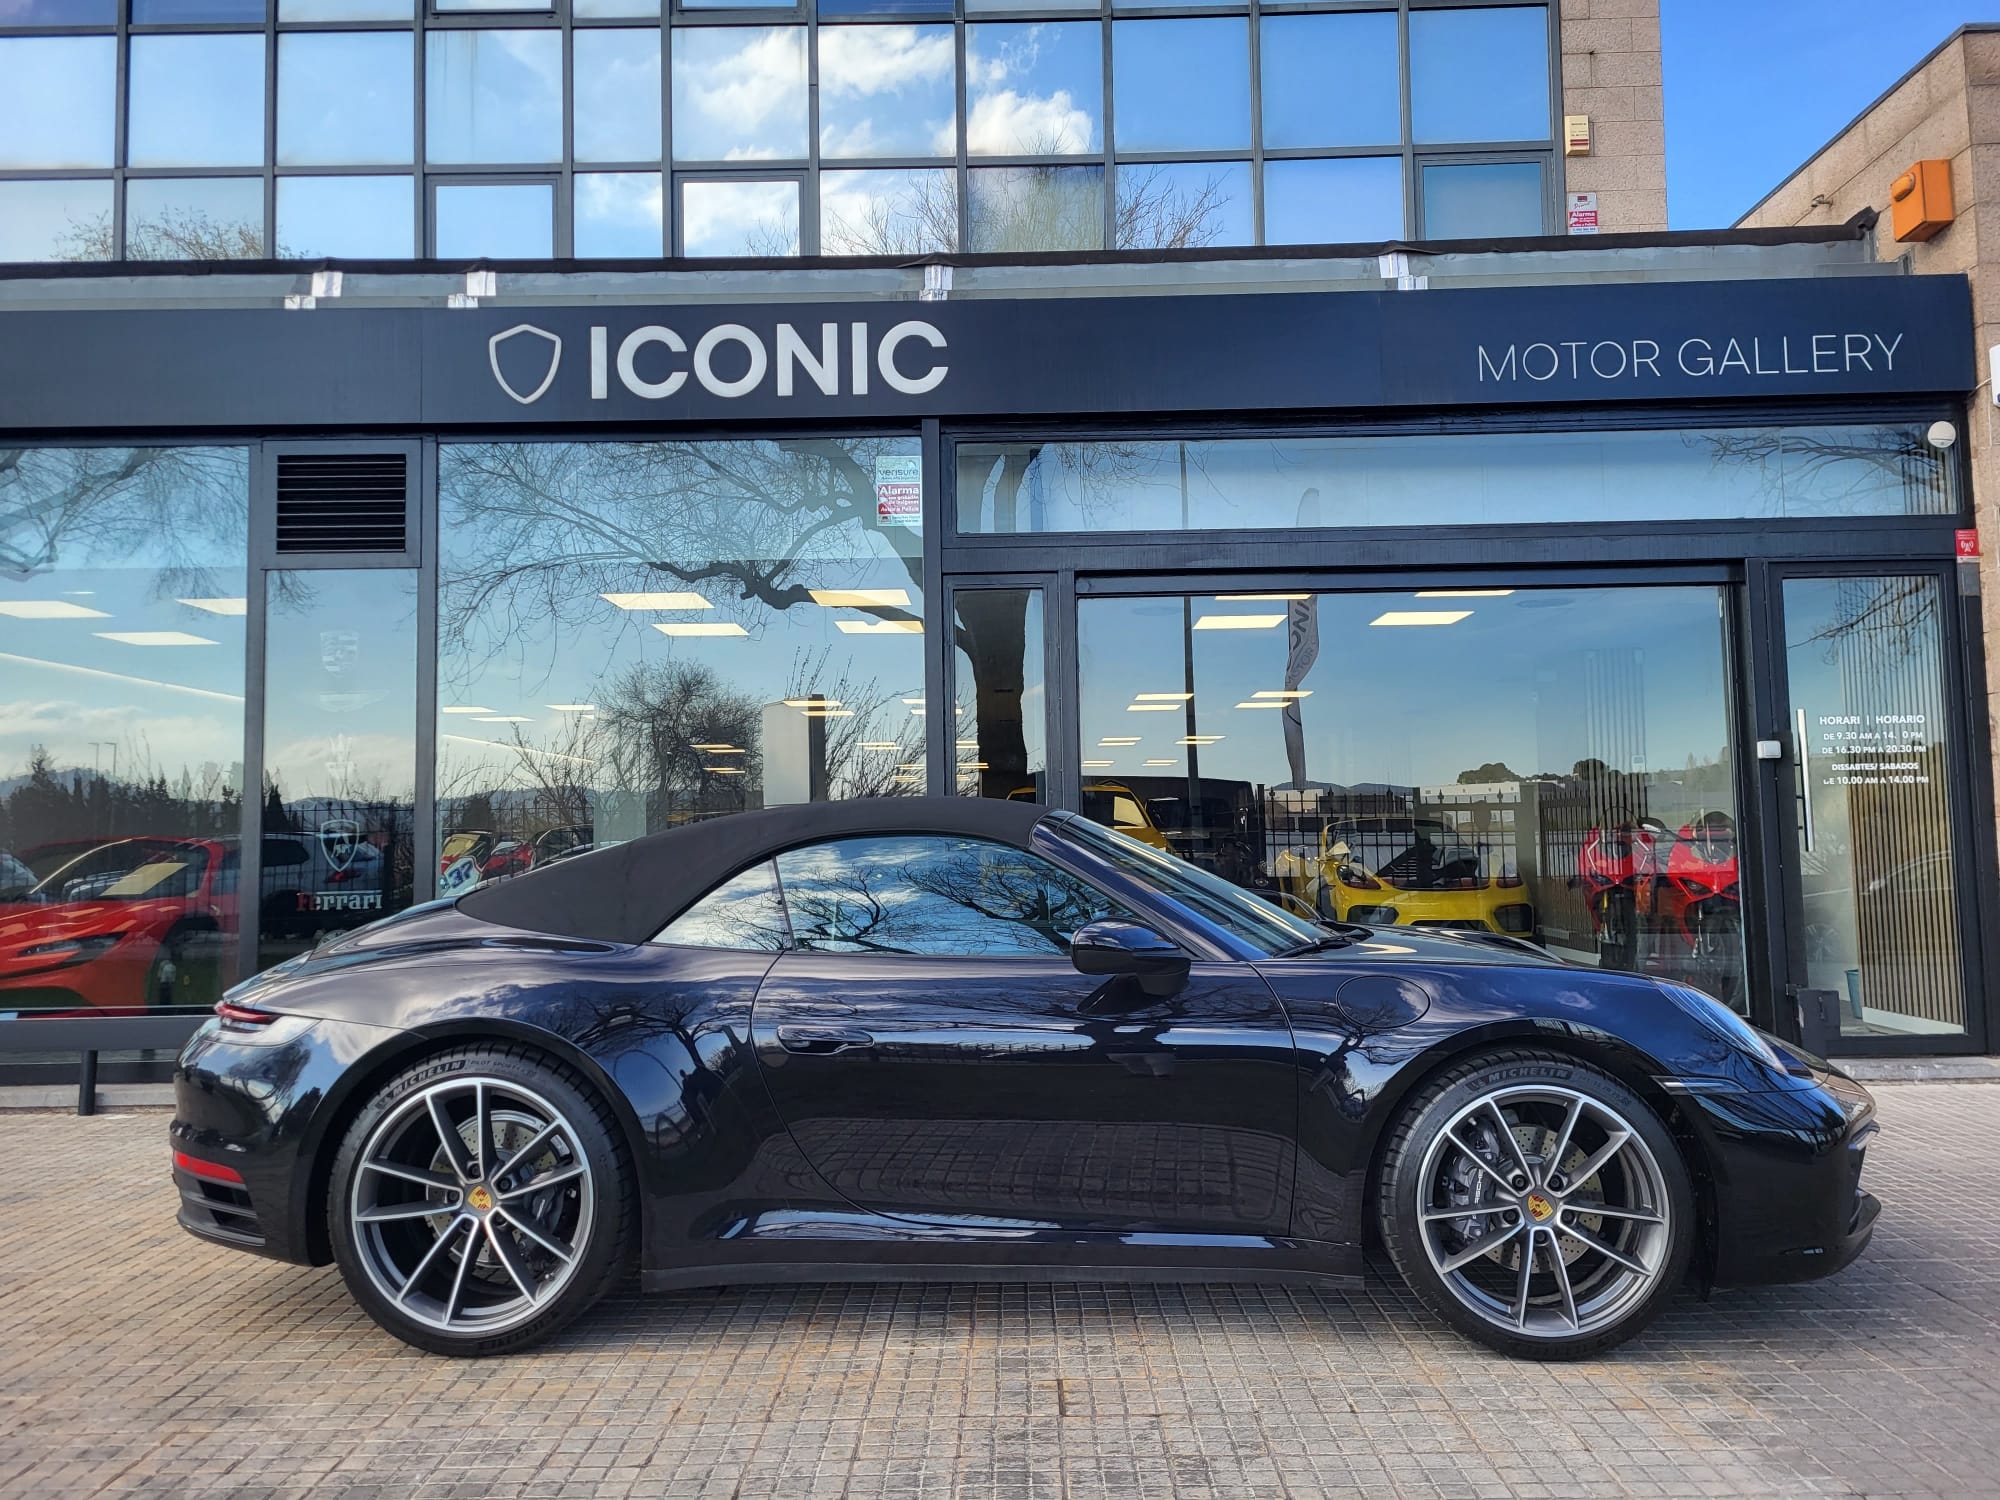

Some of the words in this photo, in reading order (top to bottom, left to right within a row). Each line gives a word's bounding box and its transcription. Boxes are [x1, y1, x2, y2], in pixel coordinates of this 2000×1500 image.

[591, 321, 949, 399] ICONIC
[1478, 340, 1661, 382] MOTOR
[1678, 333, 1904, 377] GALLERY
[879, 468, 919, 476] verisure
[880, 486, 919, 495] Alarma
[1820, 716, 1860, 725] HORARI
[1876, 715, 1925, 724] HORARIO
[1836, 732, 1857, 740] 9.30
[1886, 745, 1912, 753] 20.30
[1837, 776, 1862, 784] 10.00
[296, 890, 383, 911] Ferrari
[393, 1060, 462, 1098] MICHELIN
[1488, 1067, 1568, 1082] MICHELIN
